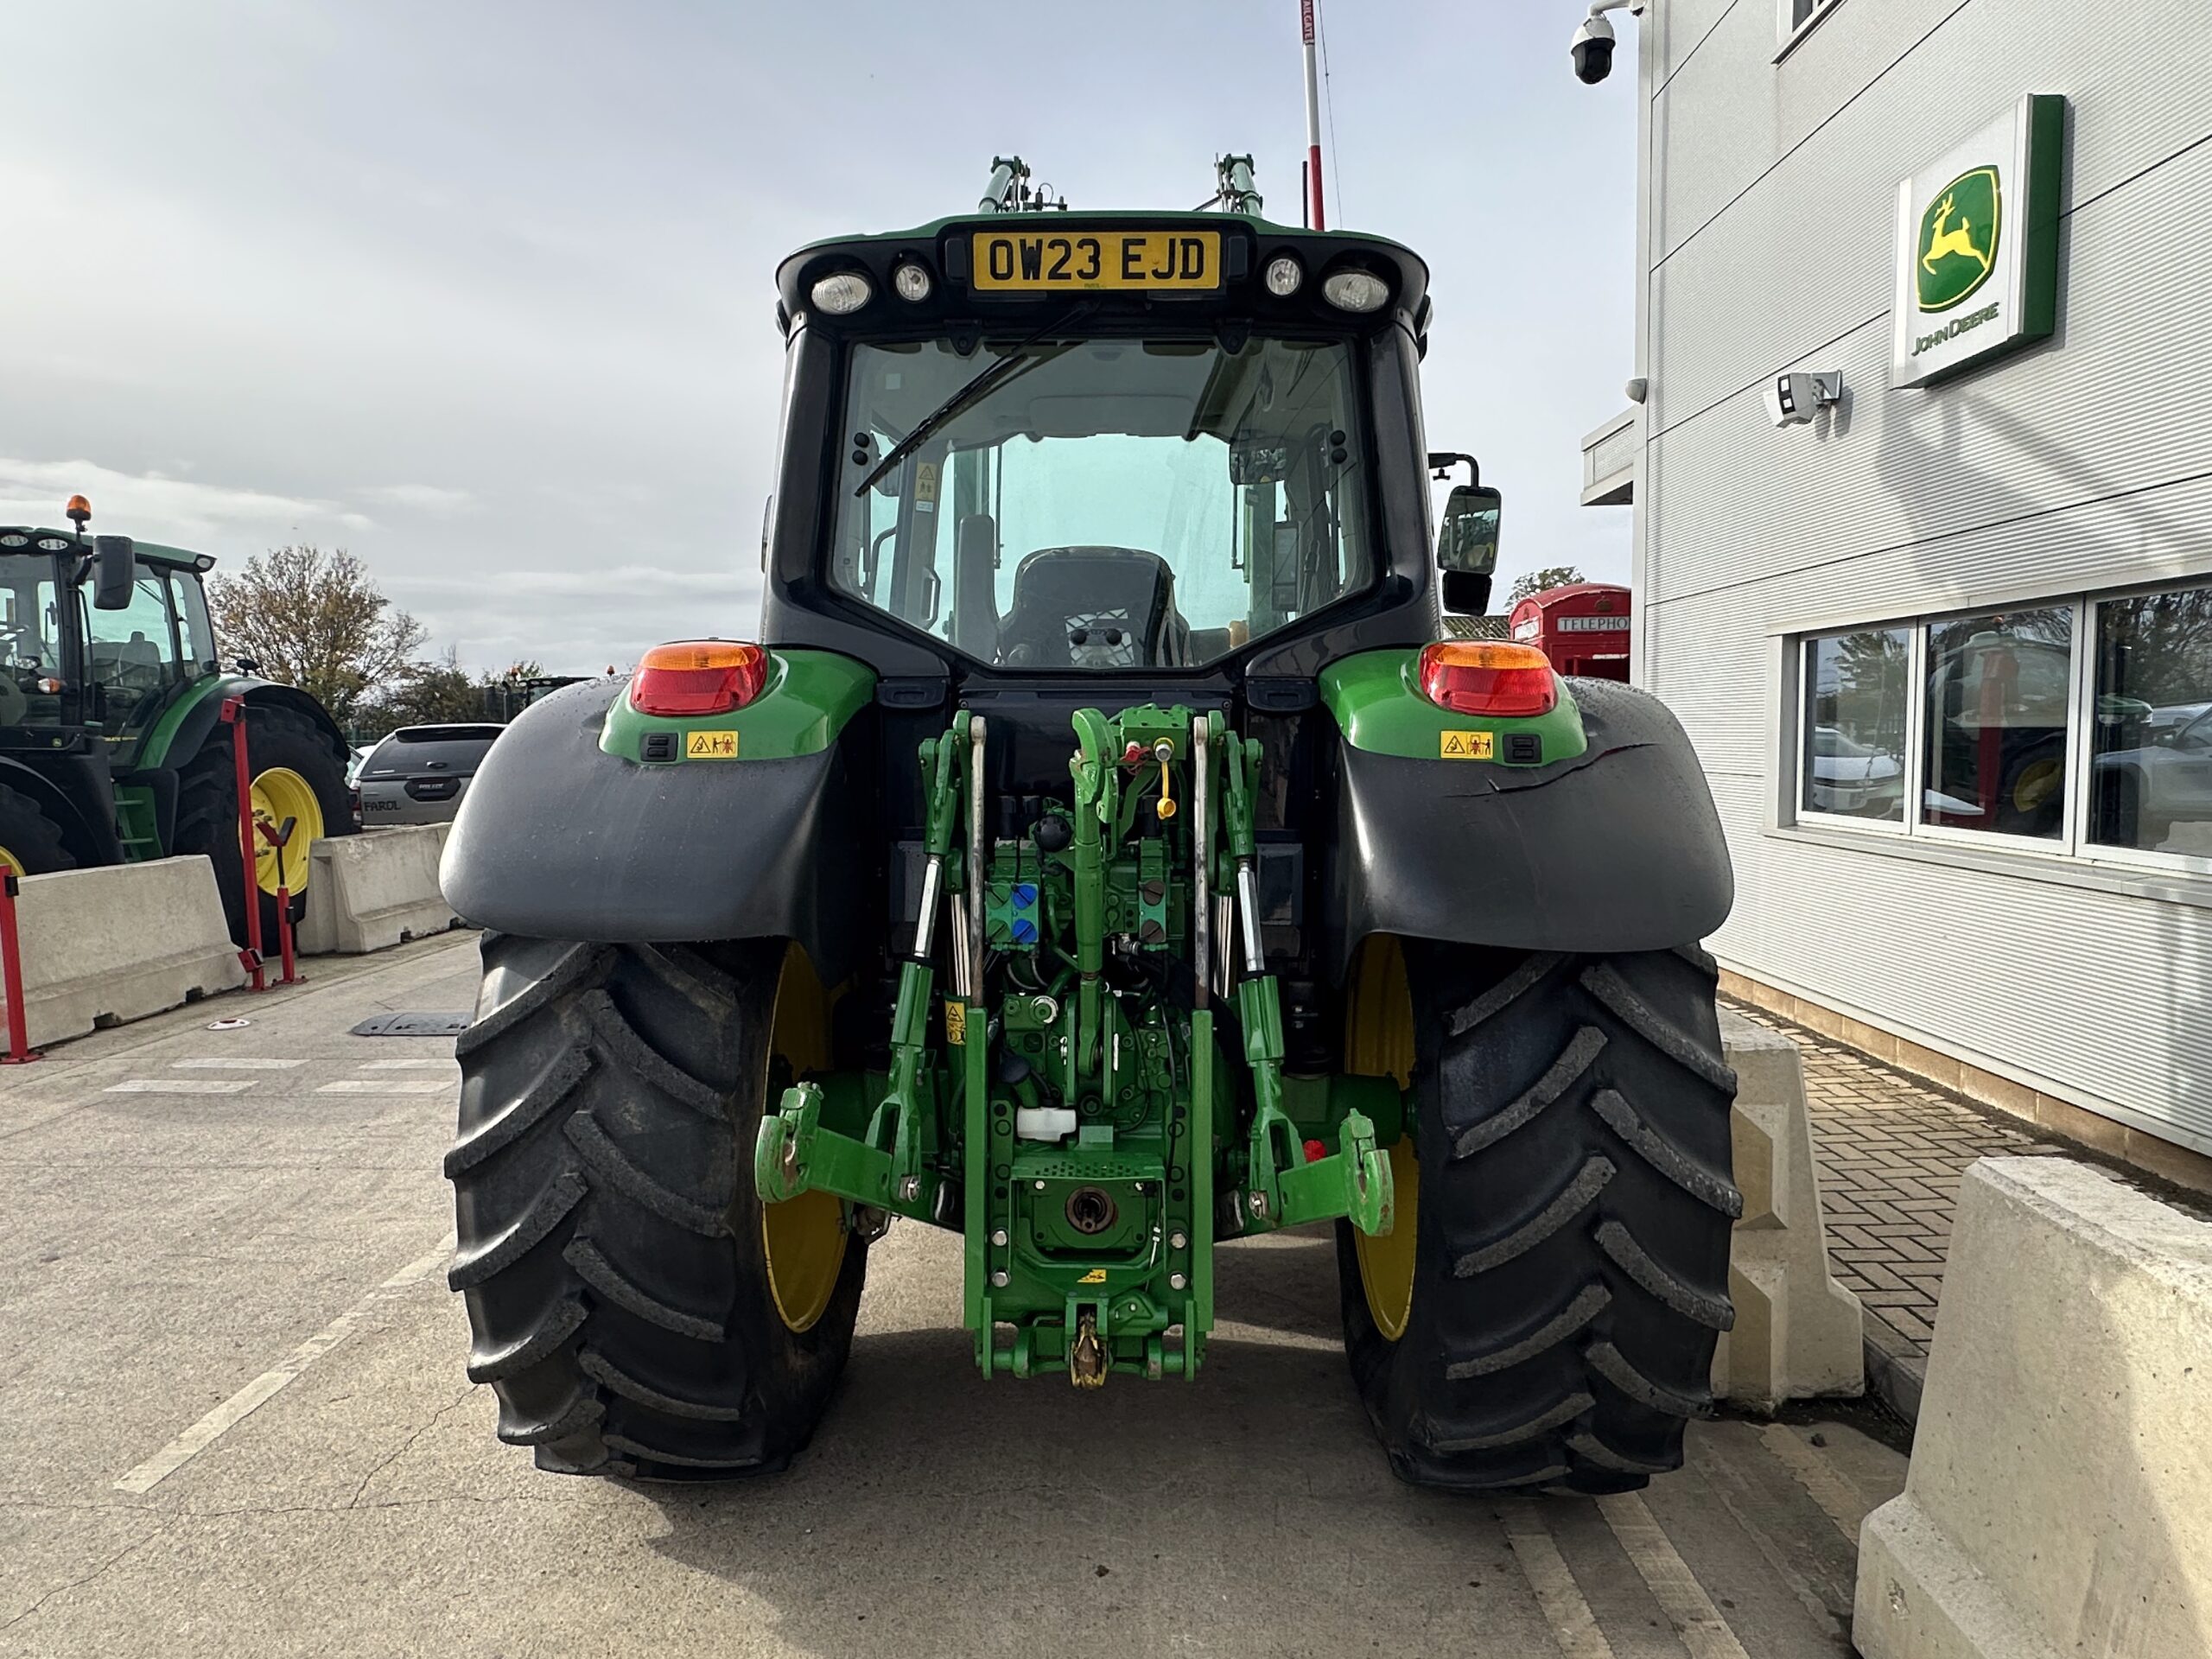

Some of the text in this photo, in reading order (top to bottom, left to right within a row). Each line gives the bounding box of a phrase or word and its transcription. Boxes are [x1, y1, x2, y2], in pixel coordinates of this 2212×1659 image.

[1302, 0, 1313, 39] AILGATE
[989, 238, 1205, 281] OW23 EJD
[1910, 302, 1999, 357] JOHN DEERE
[1561, 618, 1630, 630] TELEPHO
[364, 801, 401, 811] FAROL
